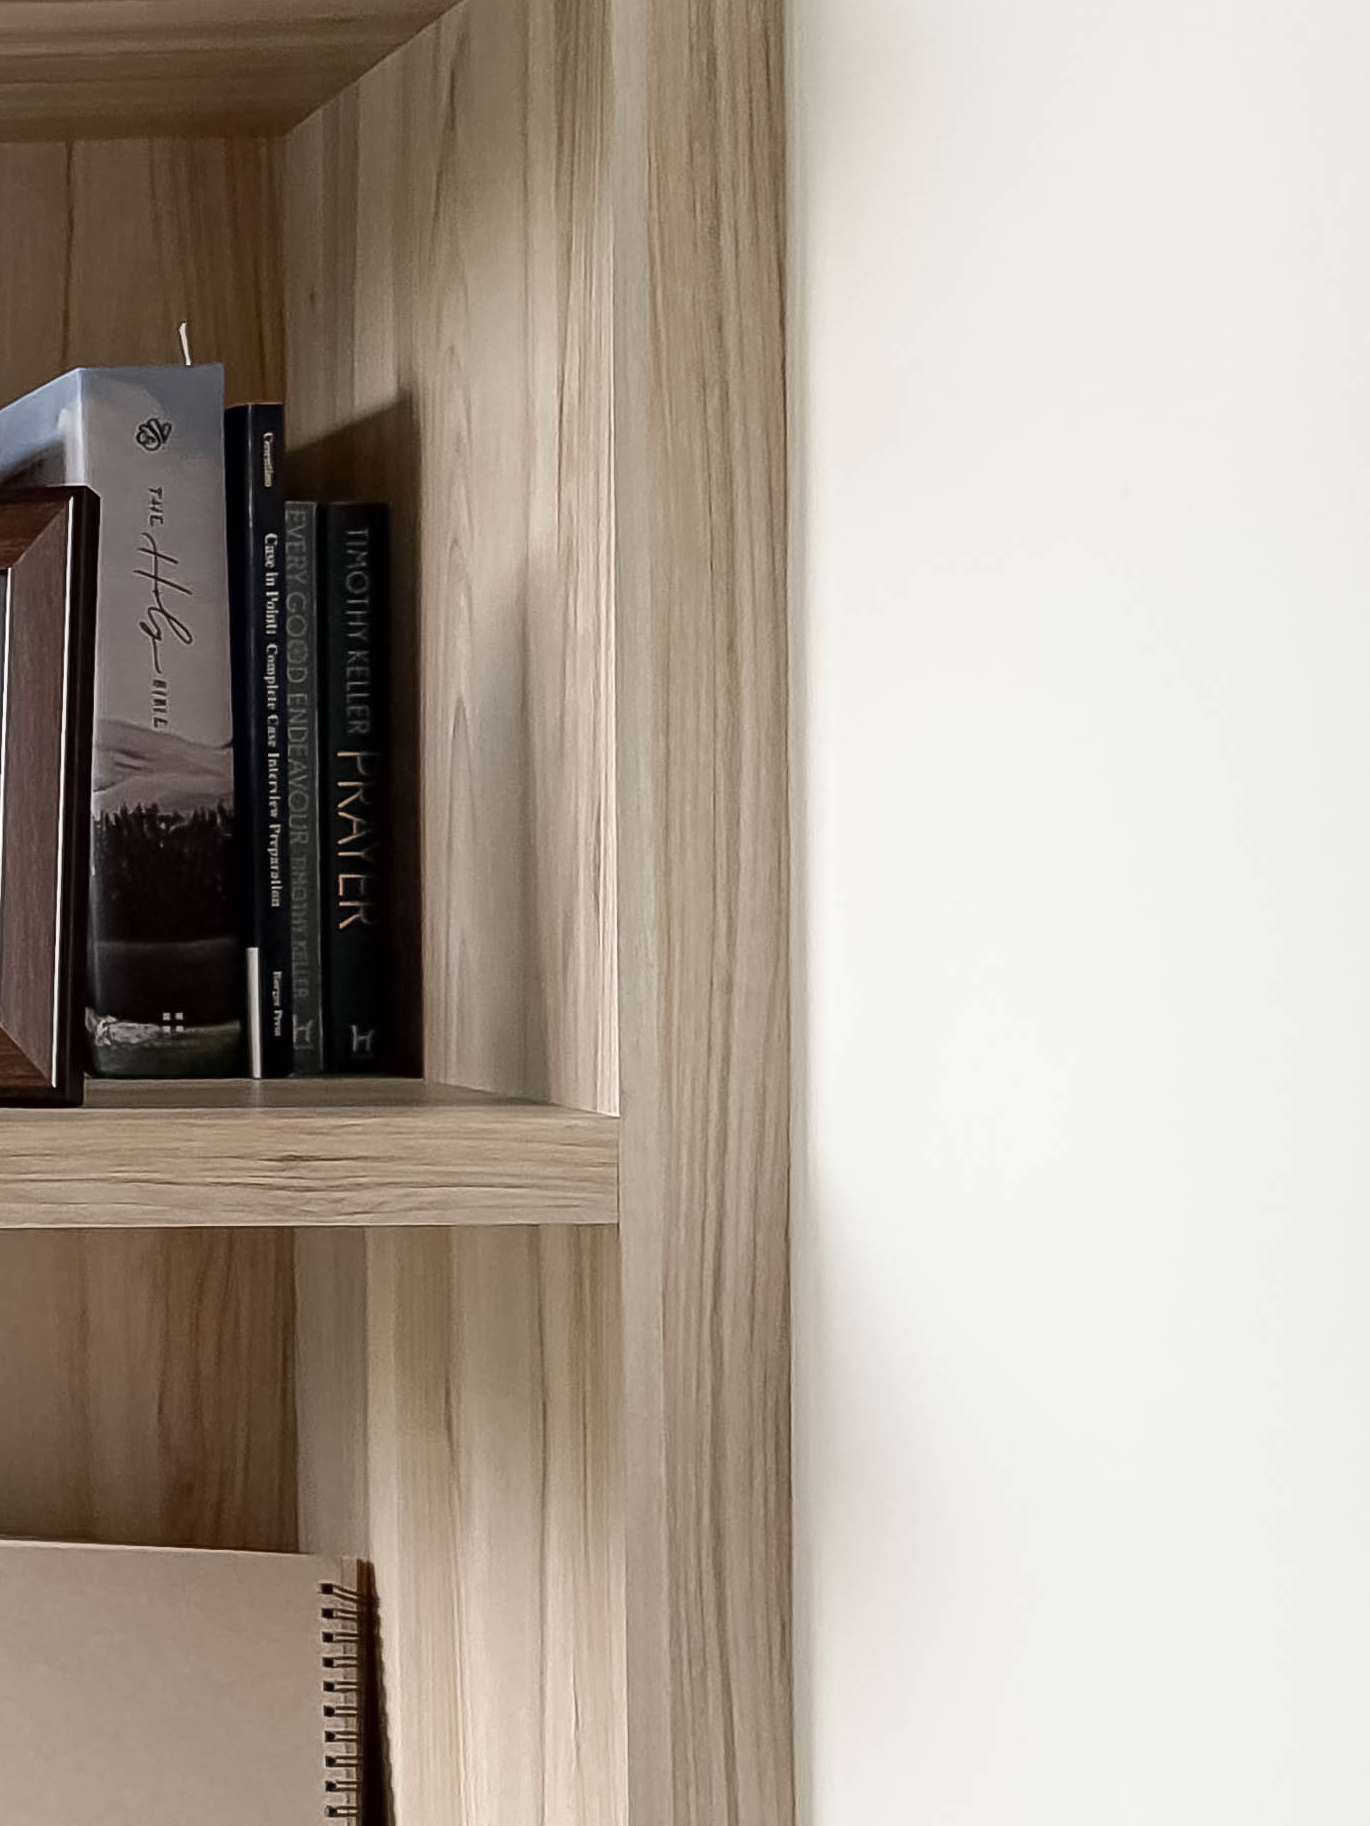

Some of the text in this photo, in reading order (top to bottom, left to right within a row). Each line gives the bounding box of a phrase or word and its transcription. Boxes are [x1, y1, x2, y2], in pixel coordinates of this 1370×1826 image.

[148, 486, 164, 526] THE
[264, 533, 278, 568] Case
[132, 531, 193, 674] Holy
[345, 528, 371, 734] TIMOTHY KELLER
[264, 643, 279, 710] Complete
[285, 510, 309, 845] EVERY GOOD ENDEAVOUR
[267, 714, 279, 748] Case
[267, 753, 281, 818] Interview
[268, 824, 283, 907] Preparation
[337, 751, 379, 929] PRAYER
[291, 855, 309, 998] TIMOTHY KELLER
